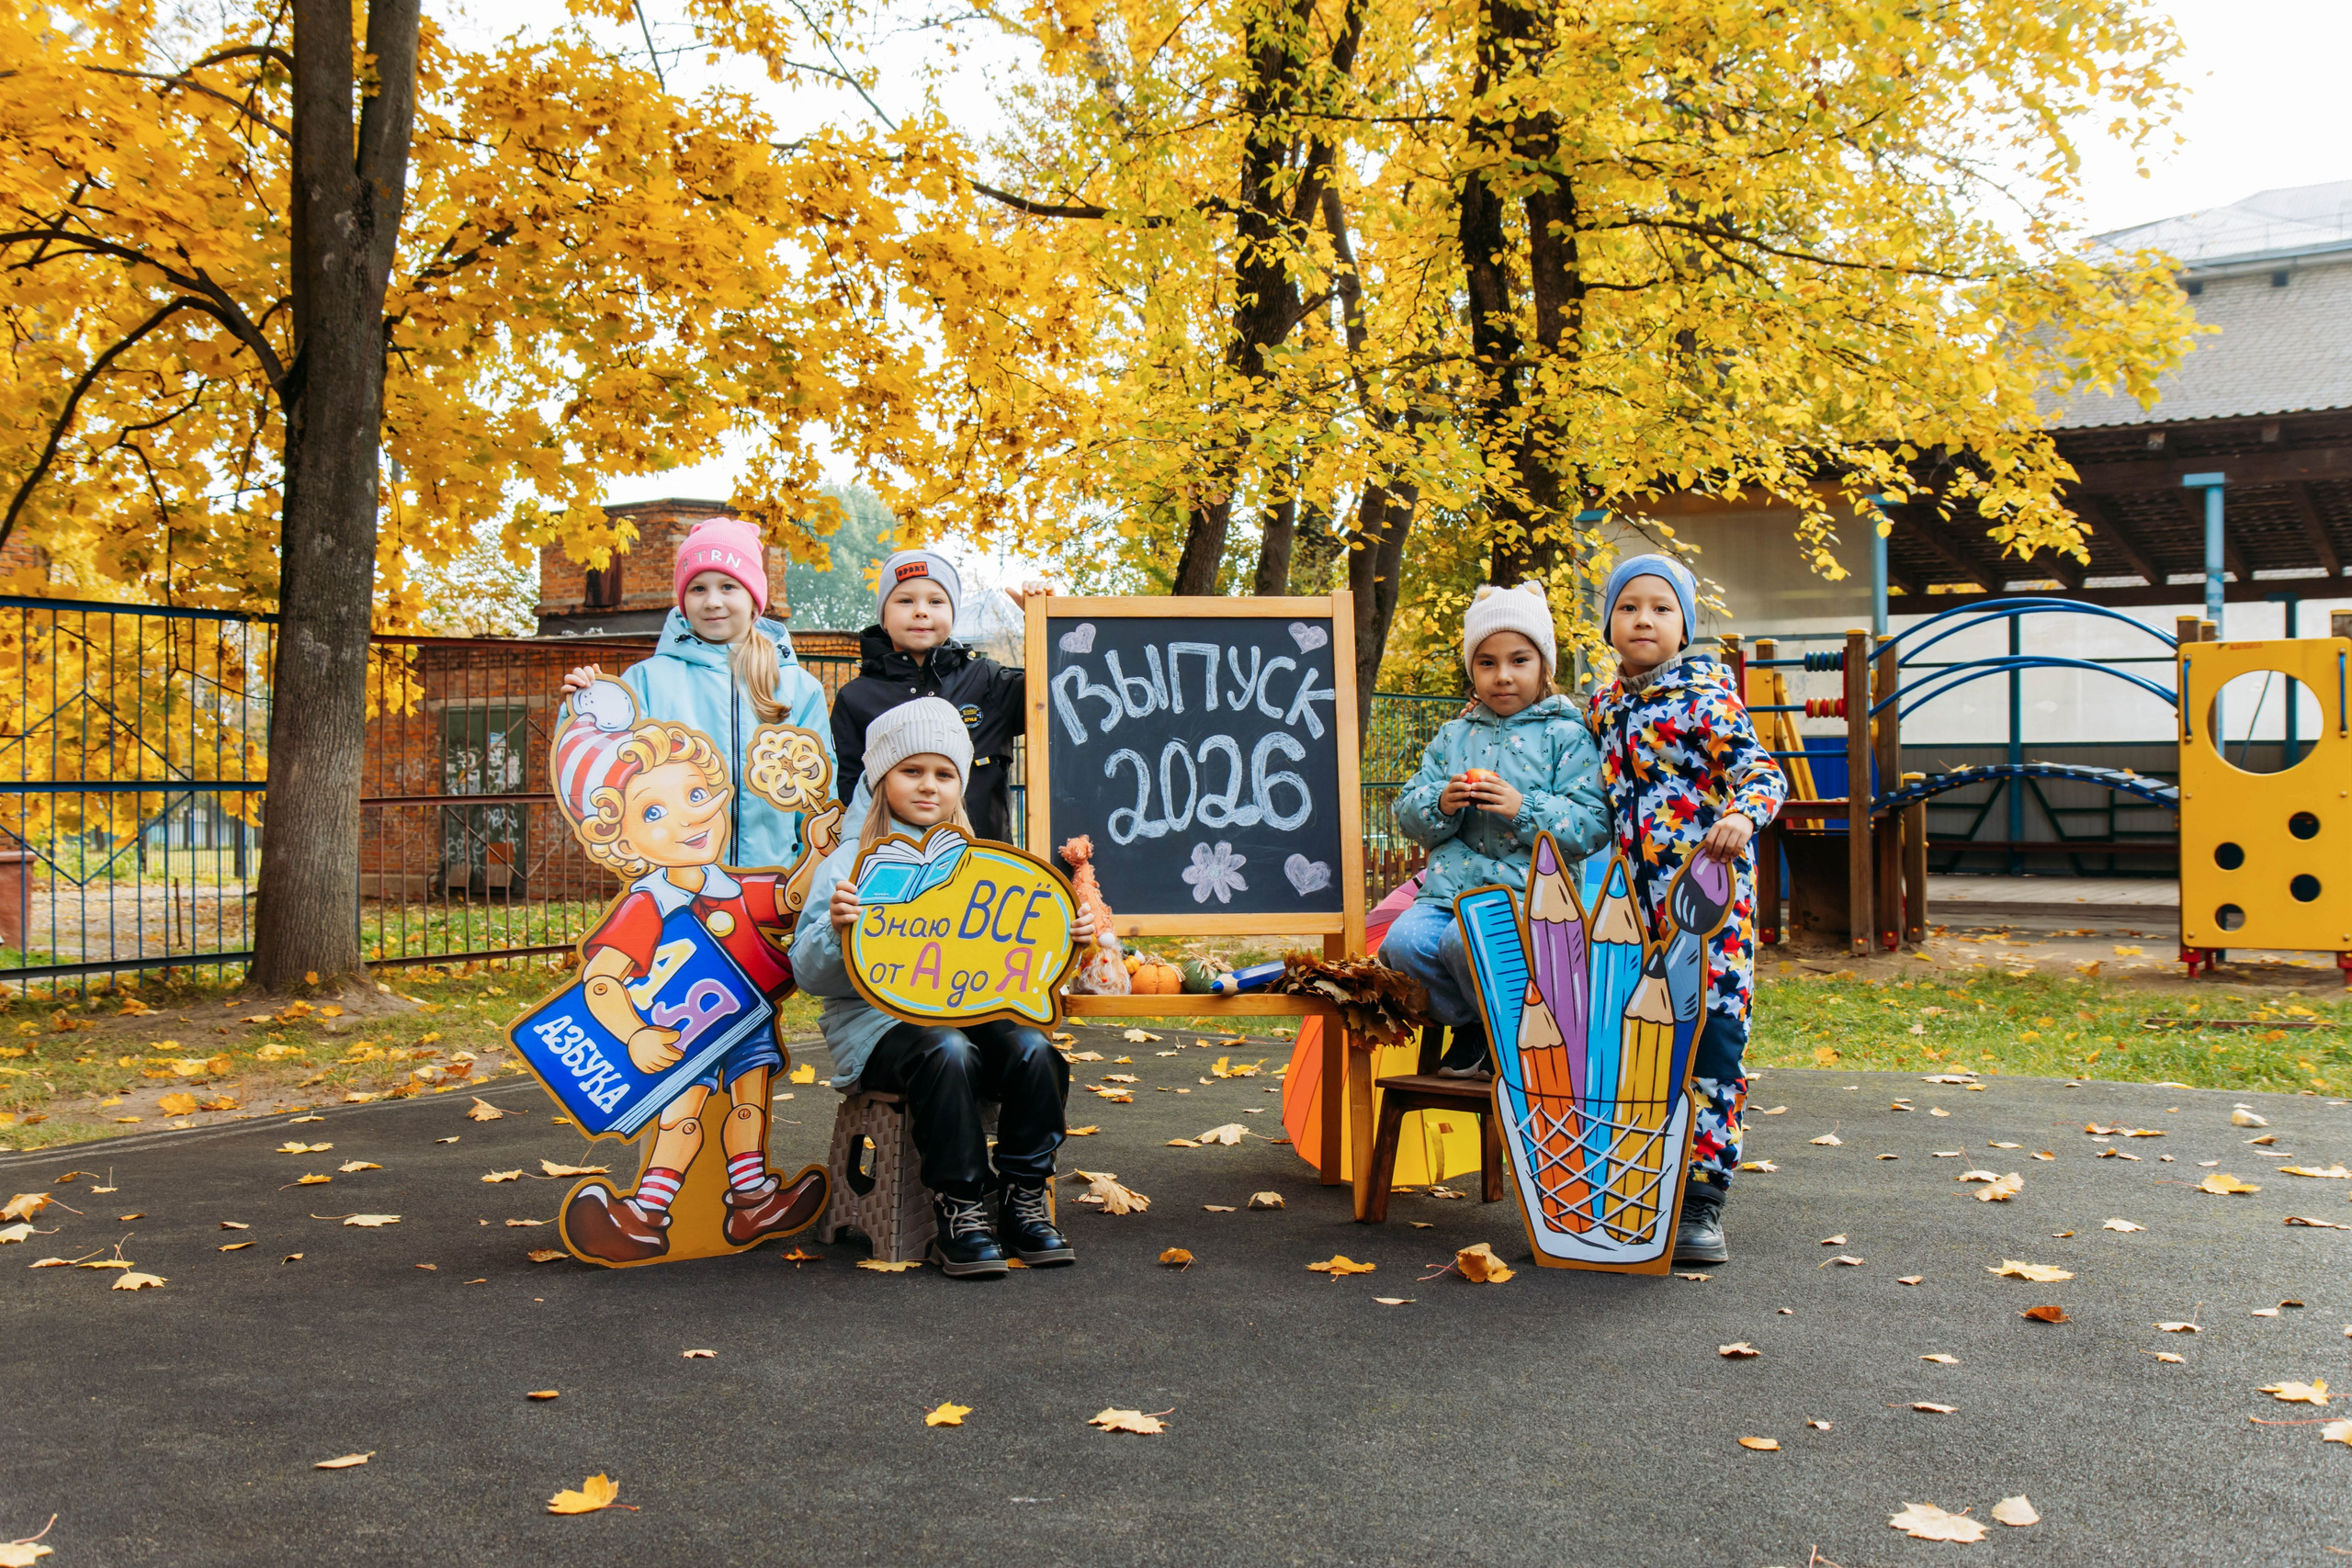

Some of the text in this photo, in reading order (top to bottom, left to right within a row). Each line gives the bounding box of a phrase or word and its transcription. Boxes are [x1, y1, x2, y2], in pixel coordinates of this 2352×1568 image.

[1050, 642, 1336, 746] ВЫПУСК
[1104, 731, 1313, 845] 2026
[864, 879, 1052, 944] Знаю ВСЁ
[868, 963, 905, 985] от
[910, 942, 942, 990] А
[946, 970, 989, 1008] до
[533, 1015, 631, 1114] АЗБУКА
